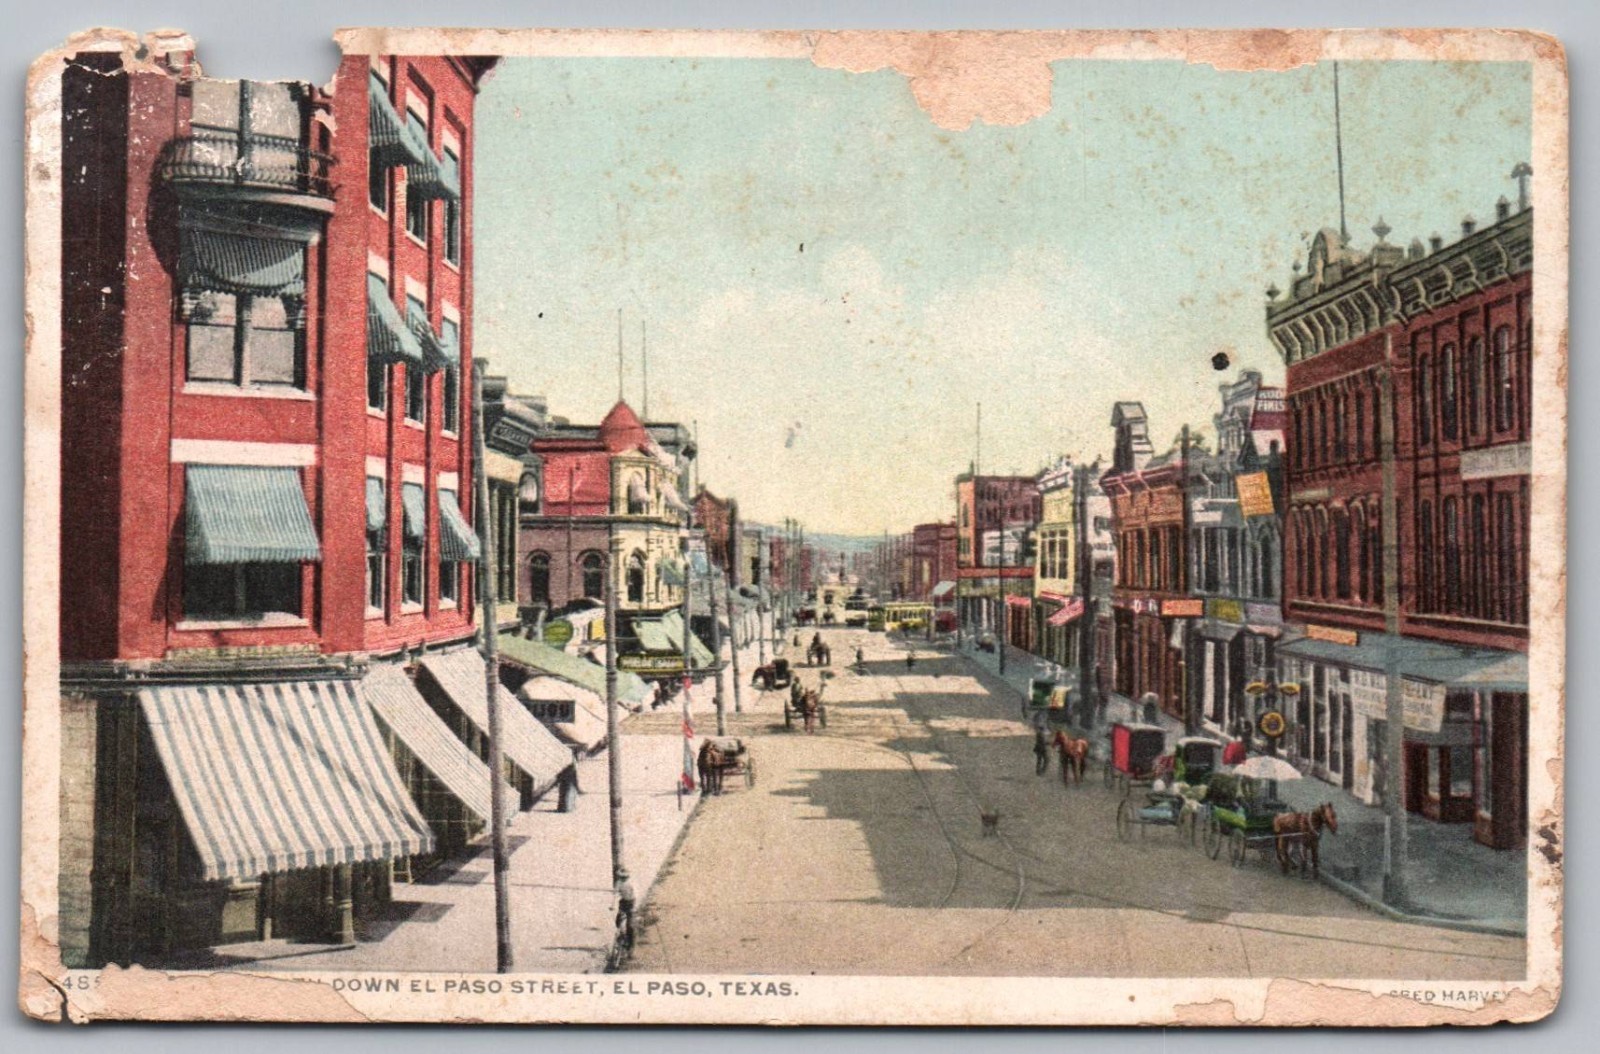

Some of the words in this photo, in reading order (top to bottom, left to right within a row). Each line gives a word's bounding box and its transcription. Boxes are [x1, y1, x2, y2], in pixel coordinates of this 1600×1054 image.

[332, 978, 399, 992] DOWN
[410, 979, 436, 992] EL
[444, 979, 503, 993] PASO
[510, 980, 604, 997] STREET,
[613, 981, 639, 994] EL
[647, 981, 712, 997] PASO,
[719, 982, 799, 995] TEXAS.
